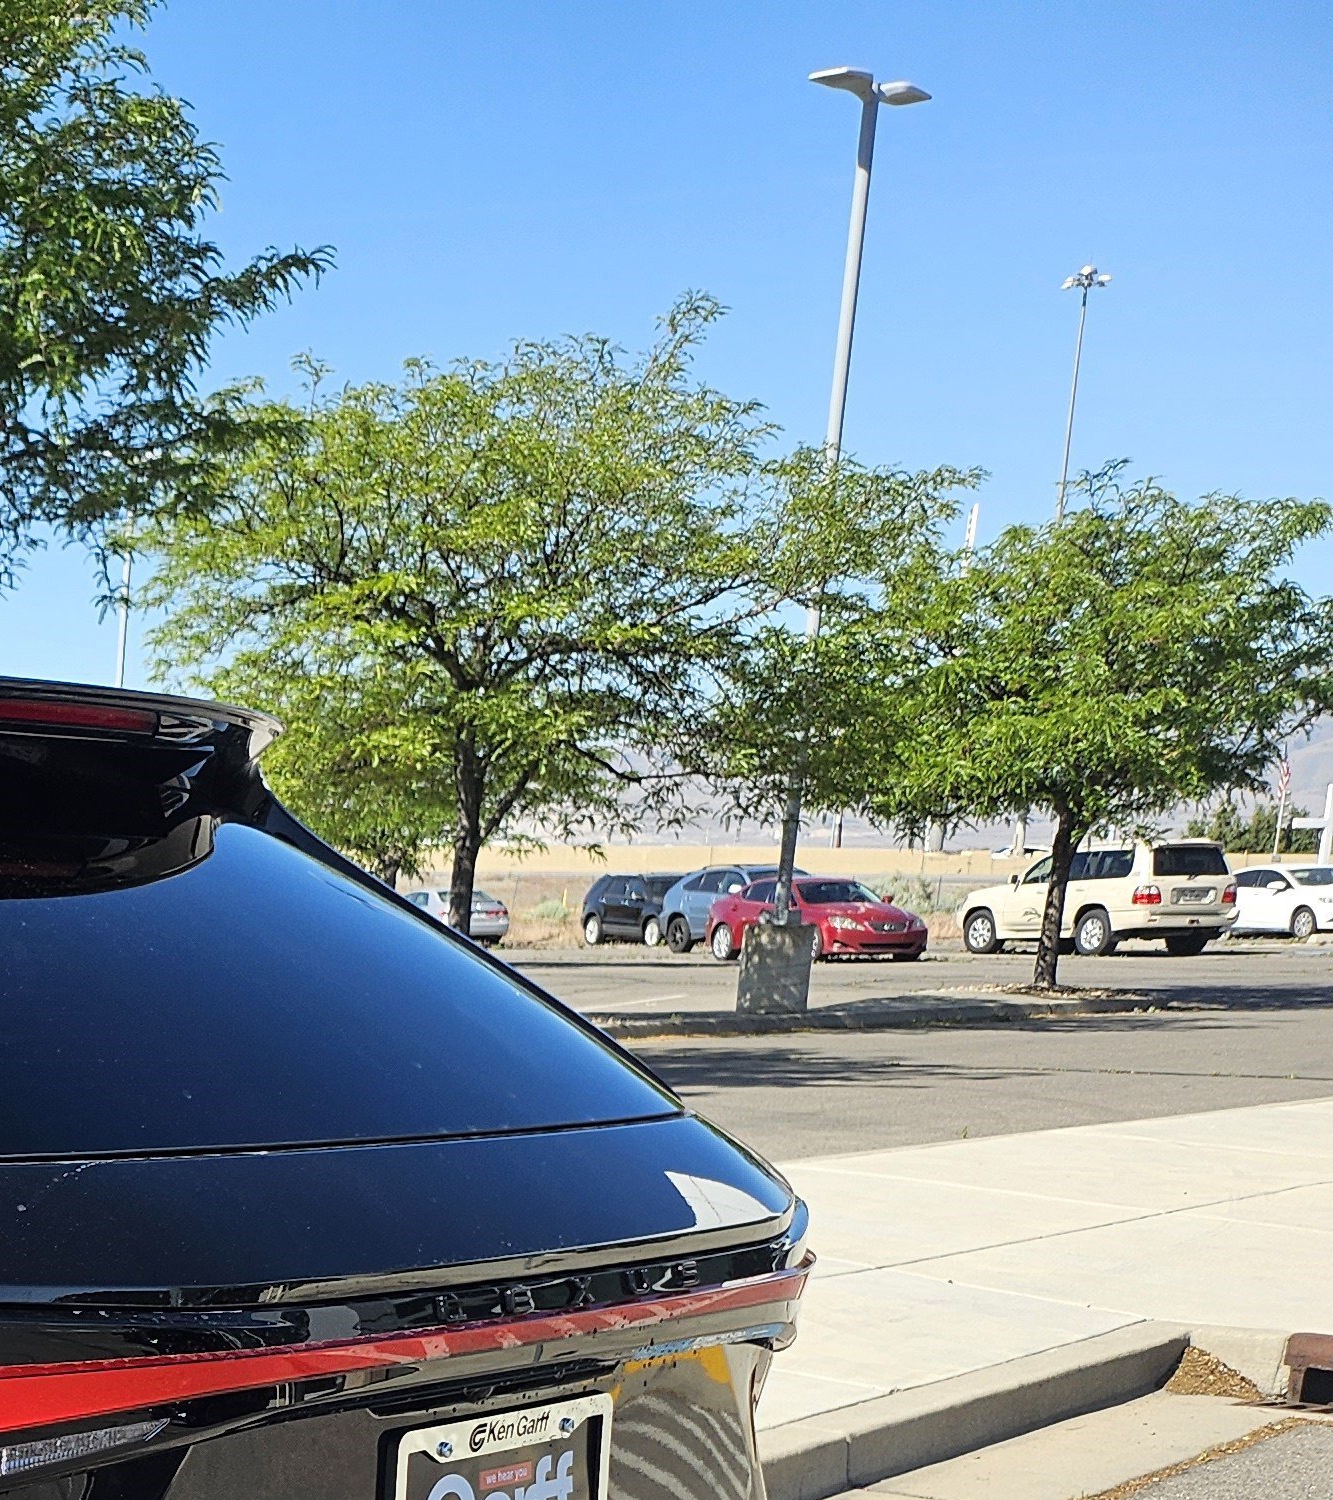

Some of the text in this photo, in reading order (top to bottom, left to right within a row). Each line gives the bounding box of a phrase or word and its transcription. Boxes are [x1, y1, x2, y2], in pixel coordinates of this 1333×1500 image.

[435, 1261, 699, 1322] LEXUS
[486, 1410, 551, 1443] Ken Garff
[485, 1466, 528, 1485] we hear you
